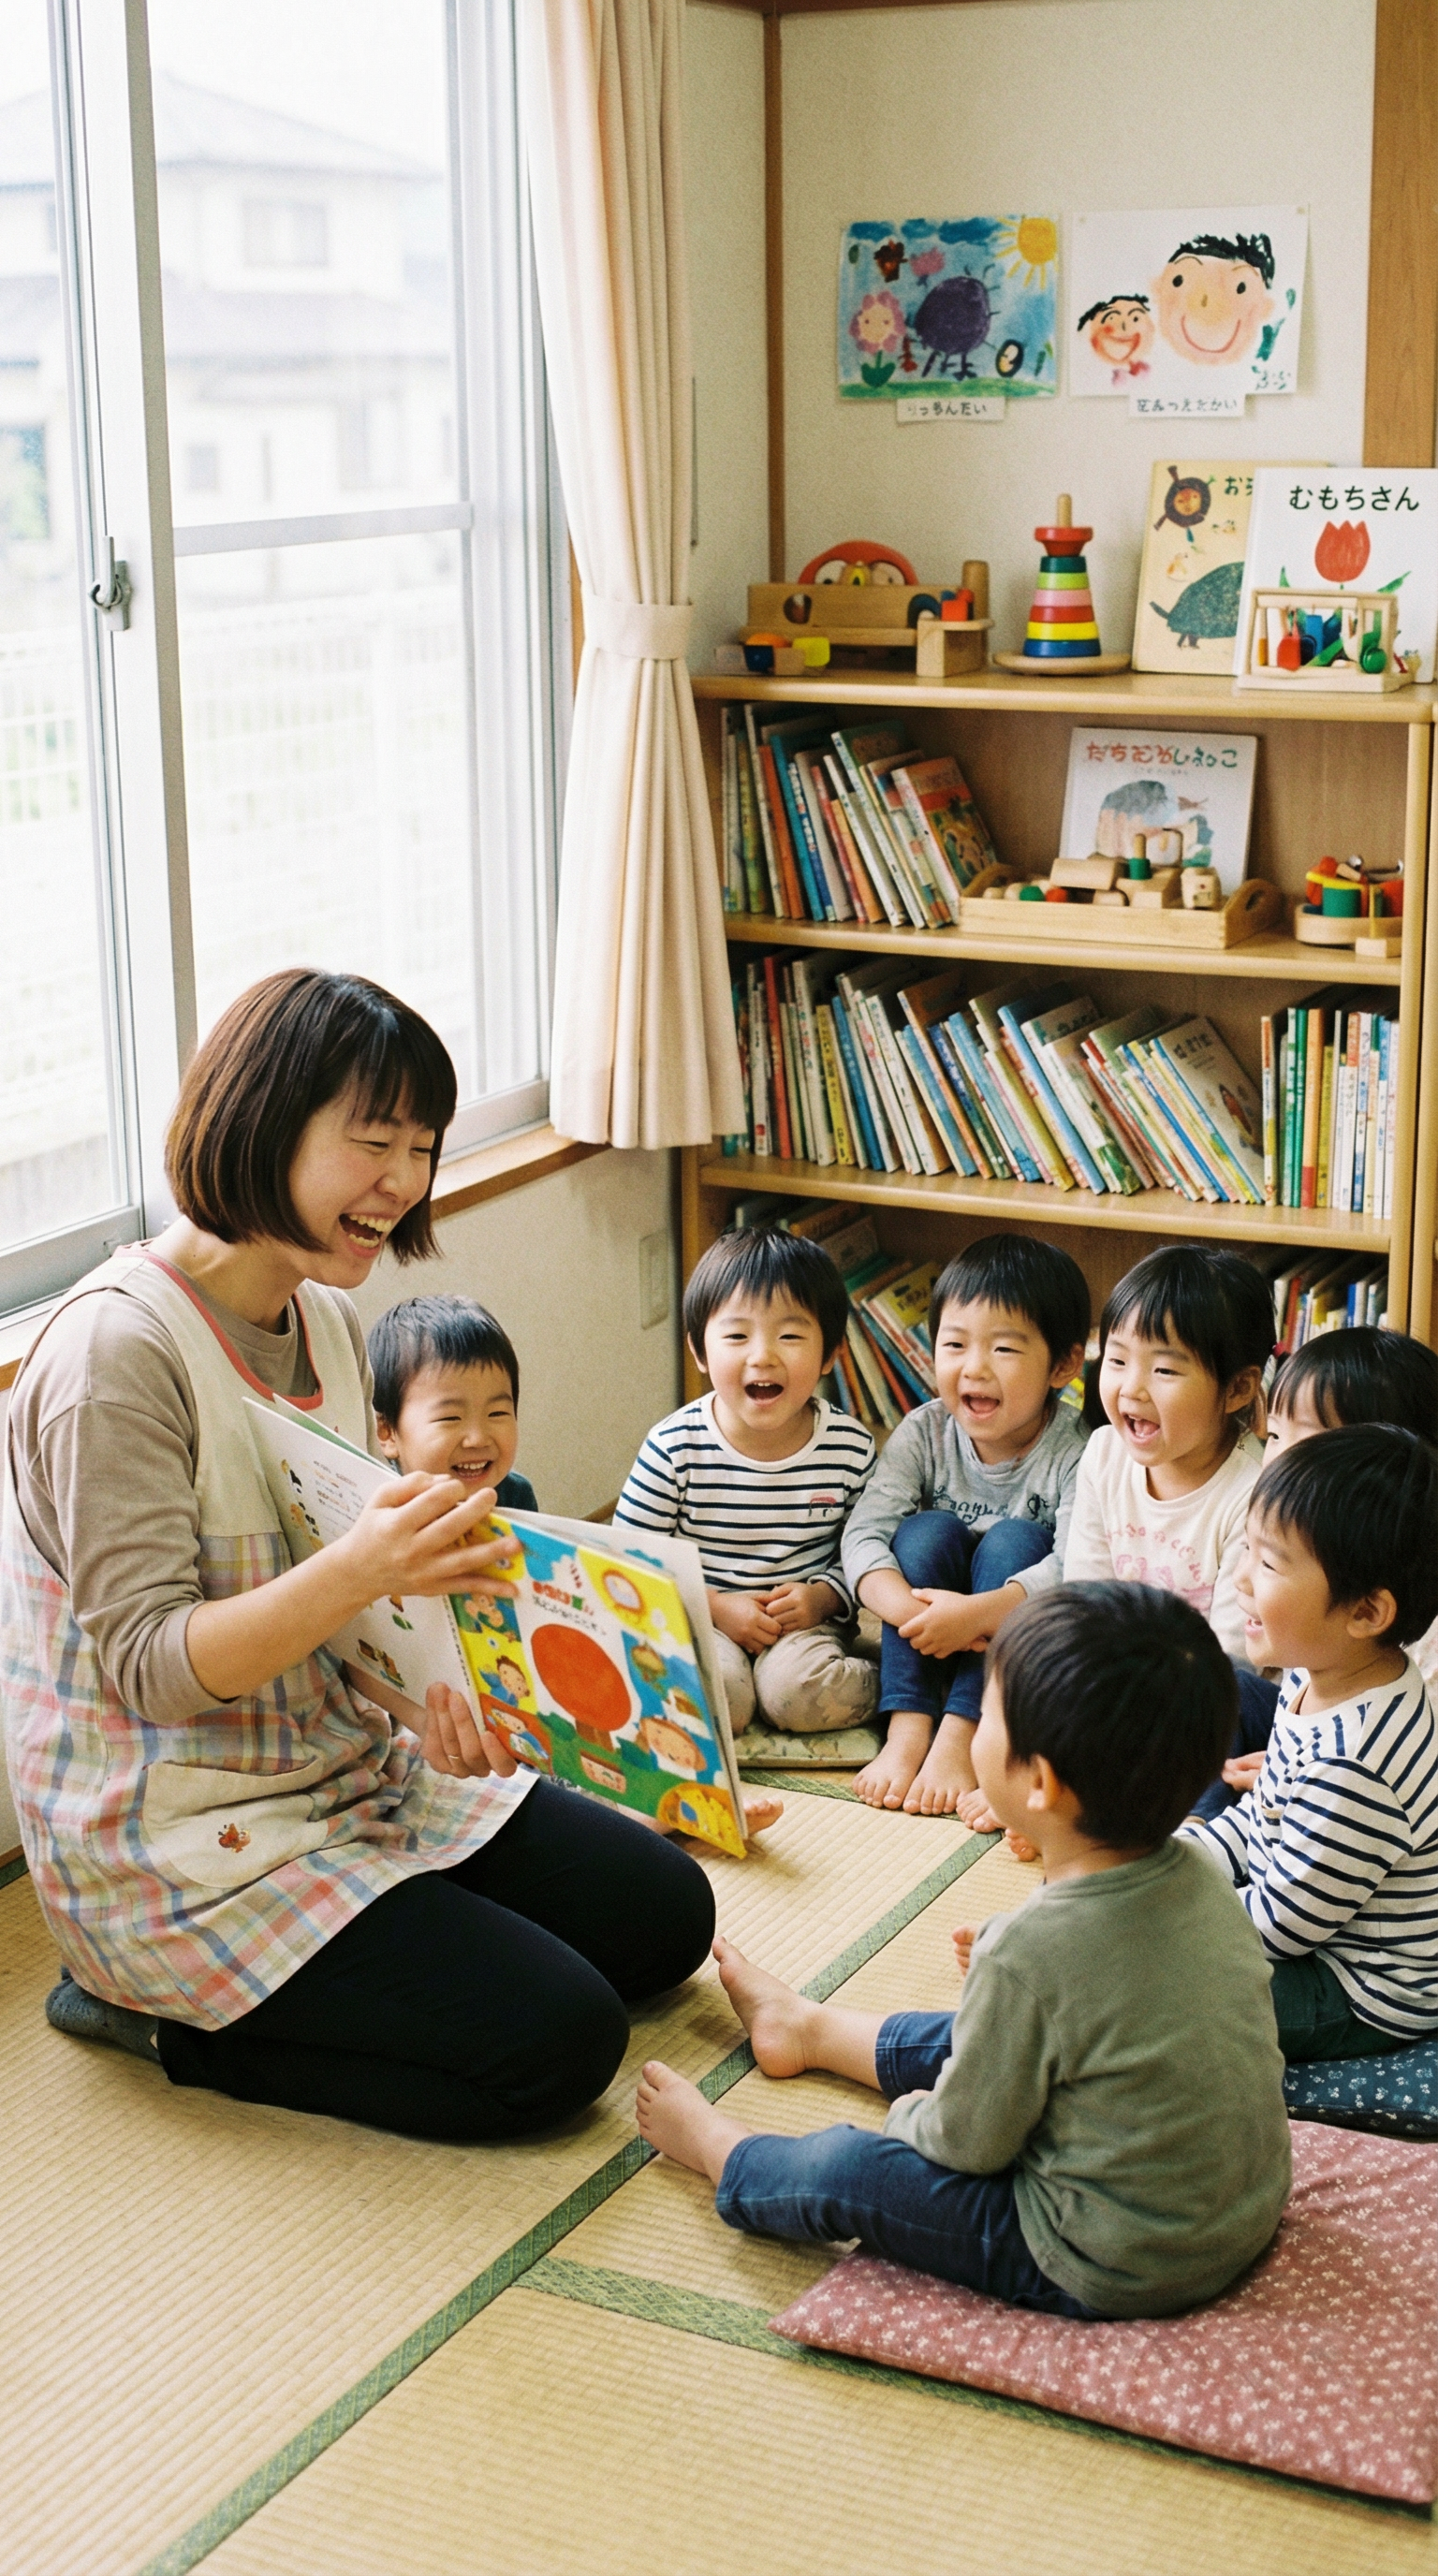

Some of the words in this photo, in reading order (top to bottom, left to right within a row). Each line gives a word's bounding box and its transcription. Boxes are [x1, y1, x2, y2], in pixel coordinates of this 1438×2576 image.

[1289, 485, 1420, 511] むもちさん
